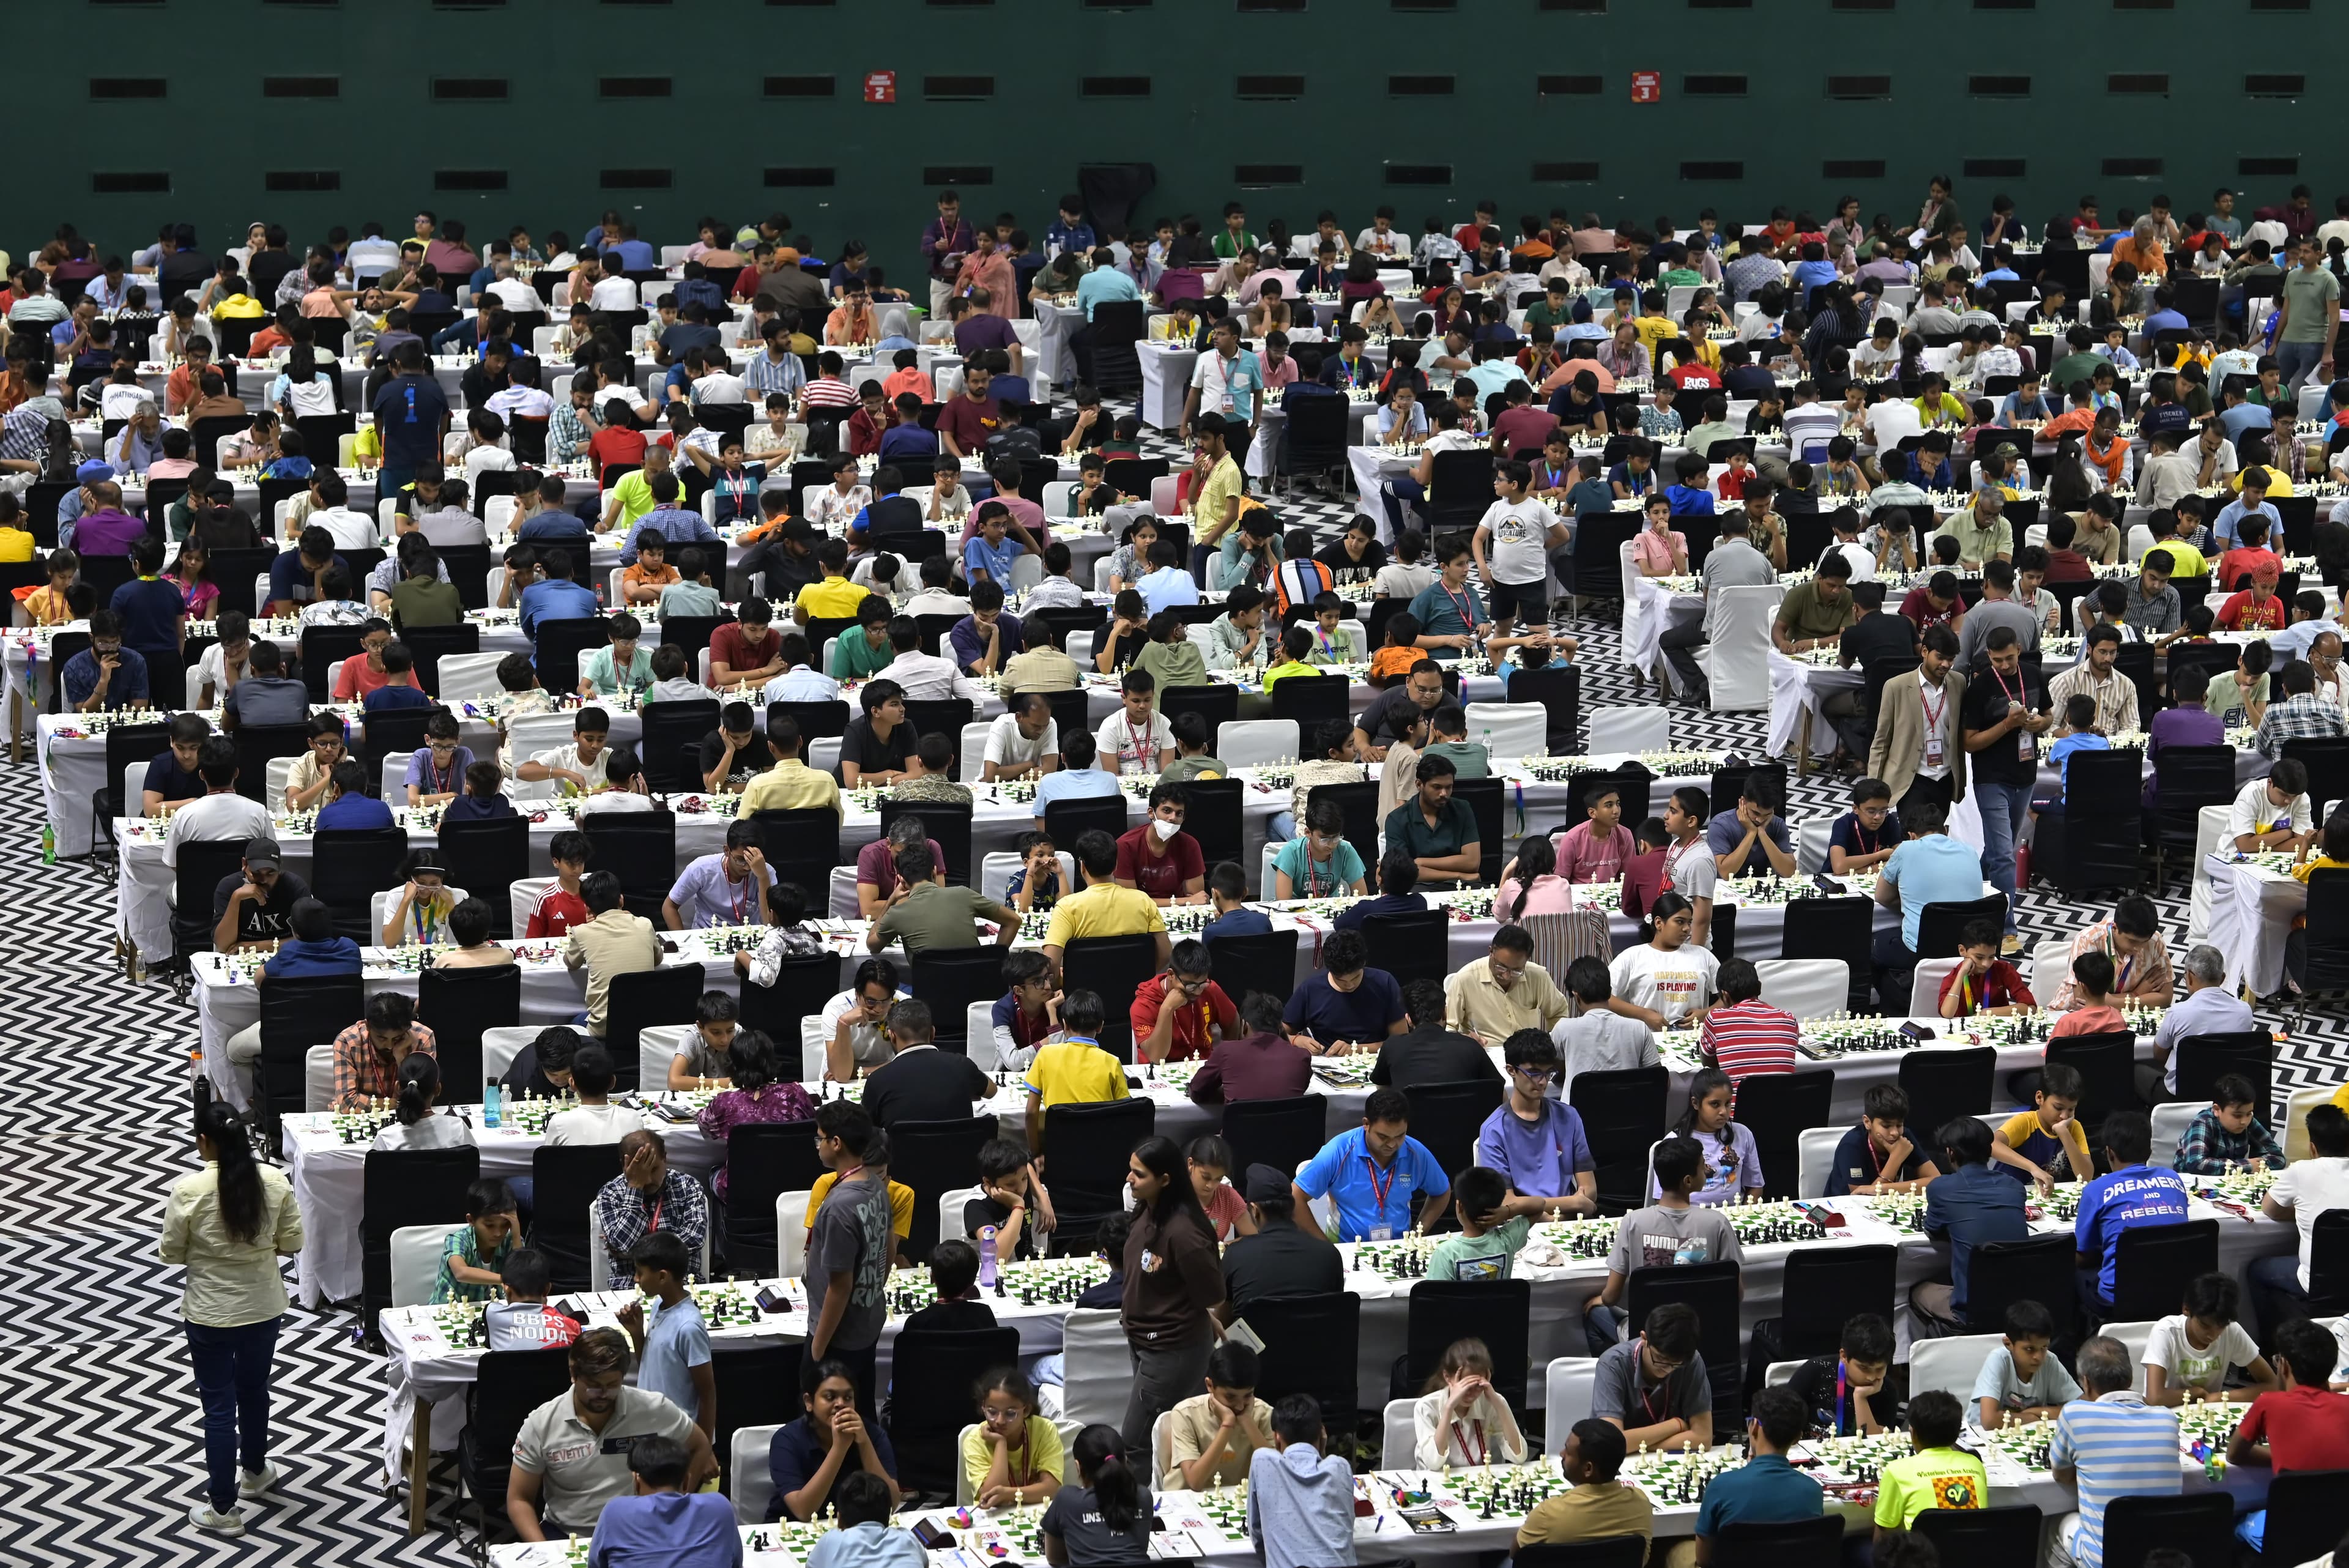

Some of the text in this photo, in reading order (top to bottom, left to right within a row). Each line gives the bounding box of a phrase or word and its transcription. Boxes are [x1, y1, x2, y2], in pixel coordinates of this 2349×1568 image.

[875, 87, 885, 99] 2
[1641, 87, 1650, 99] 3
[1683, 376, 1710, 389] BUGS
[404, 387, 418, 423] 1
[2241, 606, 2276, 615] BRAVE
[2240, 617, 2275, 626] HERT
[1653, 971, 1699, 979] HAPPINESS
[1657, 982, 1697, 992] IS PLAYING
[1664, 993, 1689, 1002] CHESS
[2103, 1176, 2186, 1202] DREAMERS
[2121, 1205, 2184, 1221] REBELS
[1642, 1235, 1679, 1250] PUMA
[513, 1312, 565, 1329] BBPS
[510, 1326, 569, 1345] NOIDA
